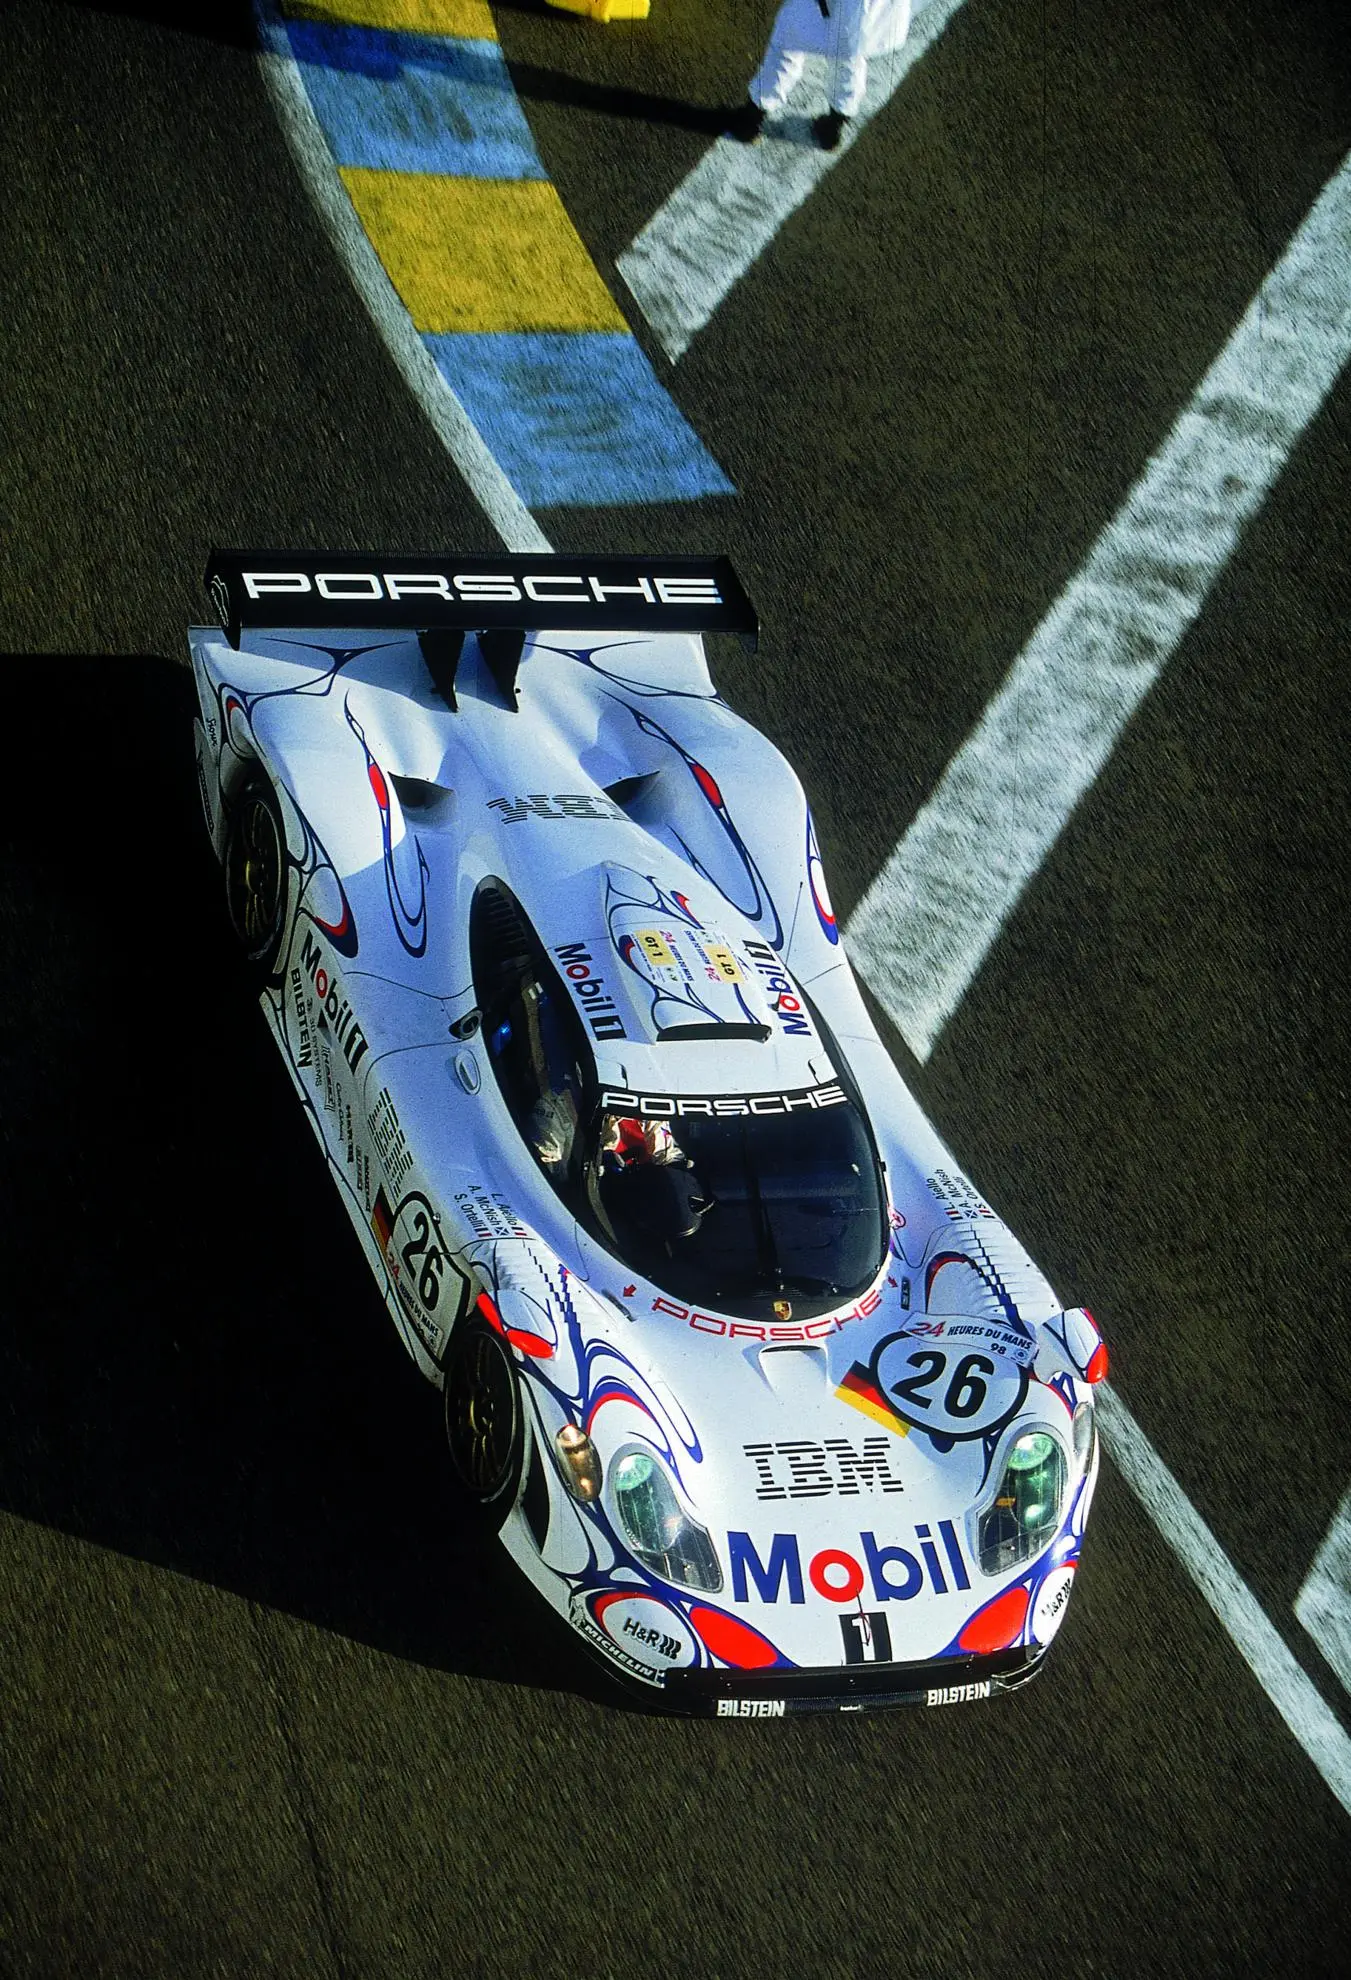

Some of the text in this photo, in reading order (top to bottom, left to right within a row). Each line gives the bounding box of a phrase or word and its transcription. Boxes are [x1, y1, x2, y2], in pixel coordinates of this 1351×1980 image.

[241, 572, 723, 605] PORSCHE
[644, 936, 659, 948] GT
[720, 962, 735, 976] GT
[301, 929, 369, 1076] Mobil 1
[554, 942, 629, 1042] Mobil 1
[754, 962, 812, 1036] Mobil
[291, 967, 313, 1068] BILSTEIN
[601, 1085, 847, 1117] PORSCHE
[367, 1087, 413, 1198] IBM
[454, 1193, 486, 1228] S. Ortelli
[467, 1185, 502, 1226] A. McNish
[925, 1178, 956, 1210] L. Aiello
[959, 1200, 972, 1209] A.
[402, 1211, 443, 1312] 26
[652, 1289, 882, 1341] PORSCHE
[910, 1320, 1033, 1350] 24 HEURES DU MANS
[990, 1343, 1007, 1355] 98
[890, 1350, 995, 1418] 26
[742, 1436, 904, 1501] IBM
[727, 1519, 971, 1605] Mobil
[584, 1623, 655, 1679] MICHELIN
[623, 1617, 660, 1649] H&R
[844, 1612, 886, 1663] 1
[716, 1699, 786, 1718] BILSTEIN
[926, 1681, 991, 1707] BILSTEIN
